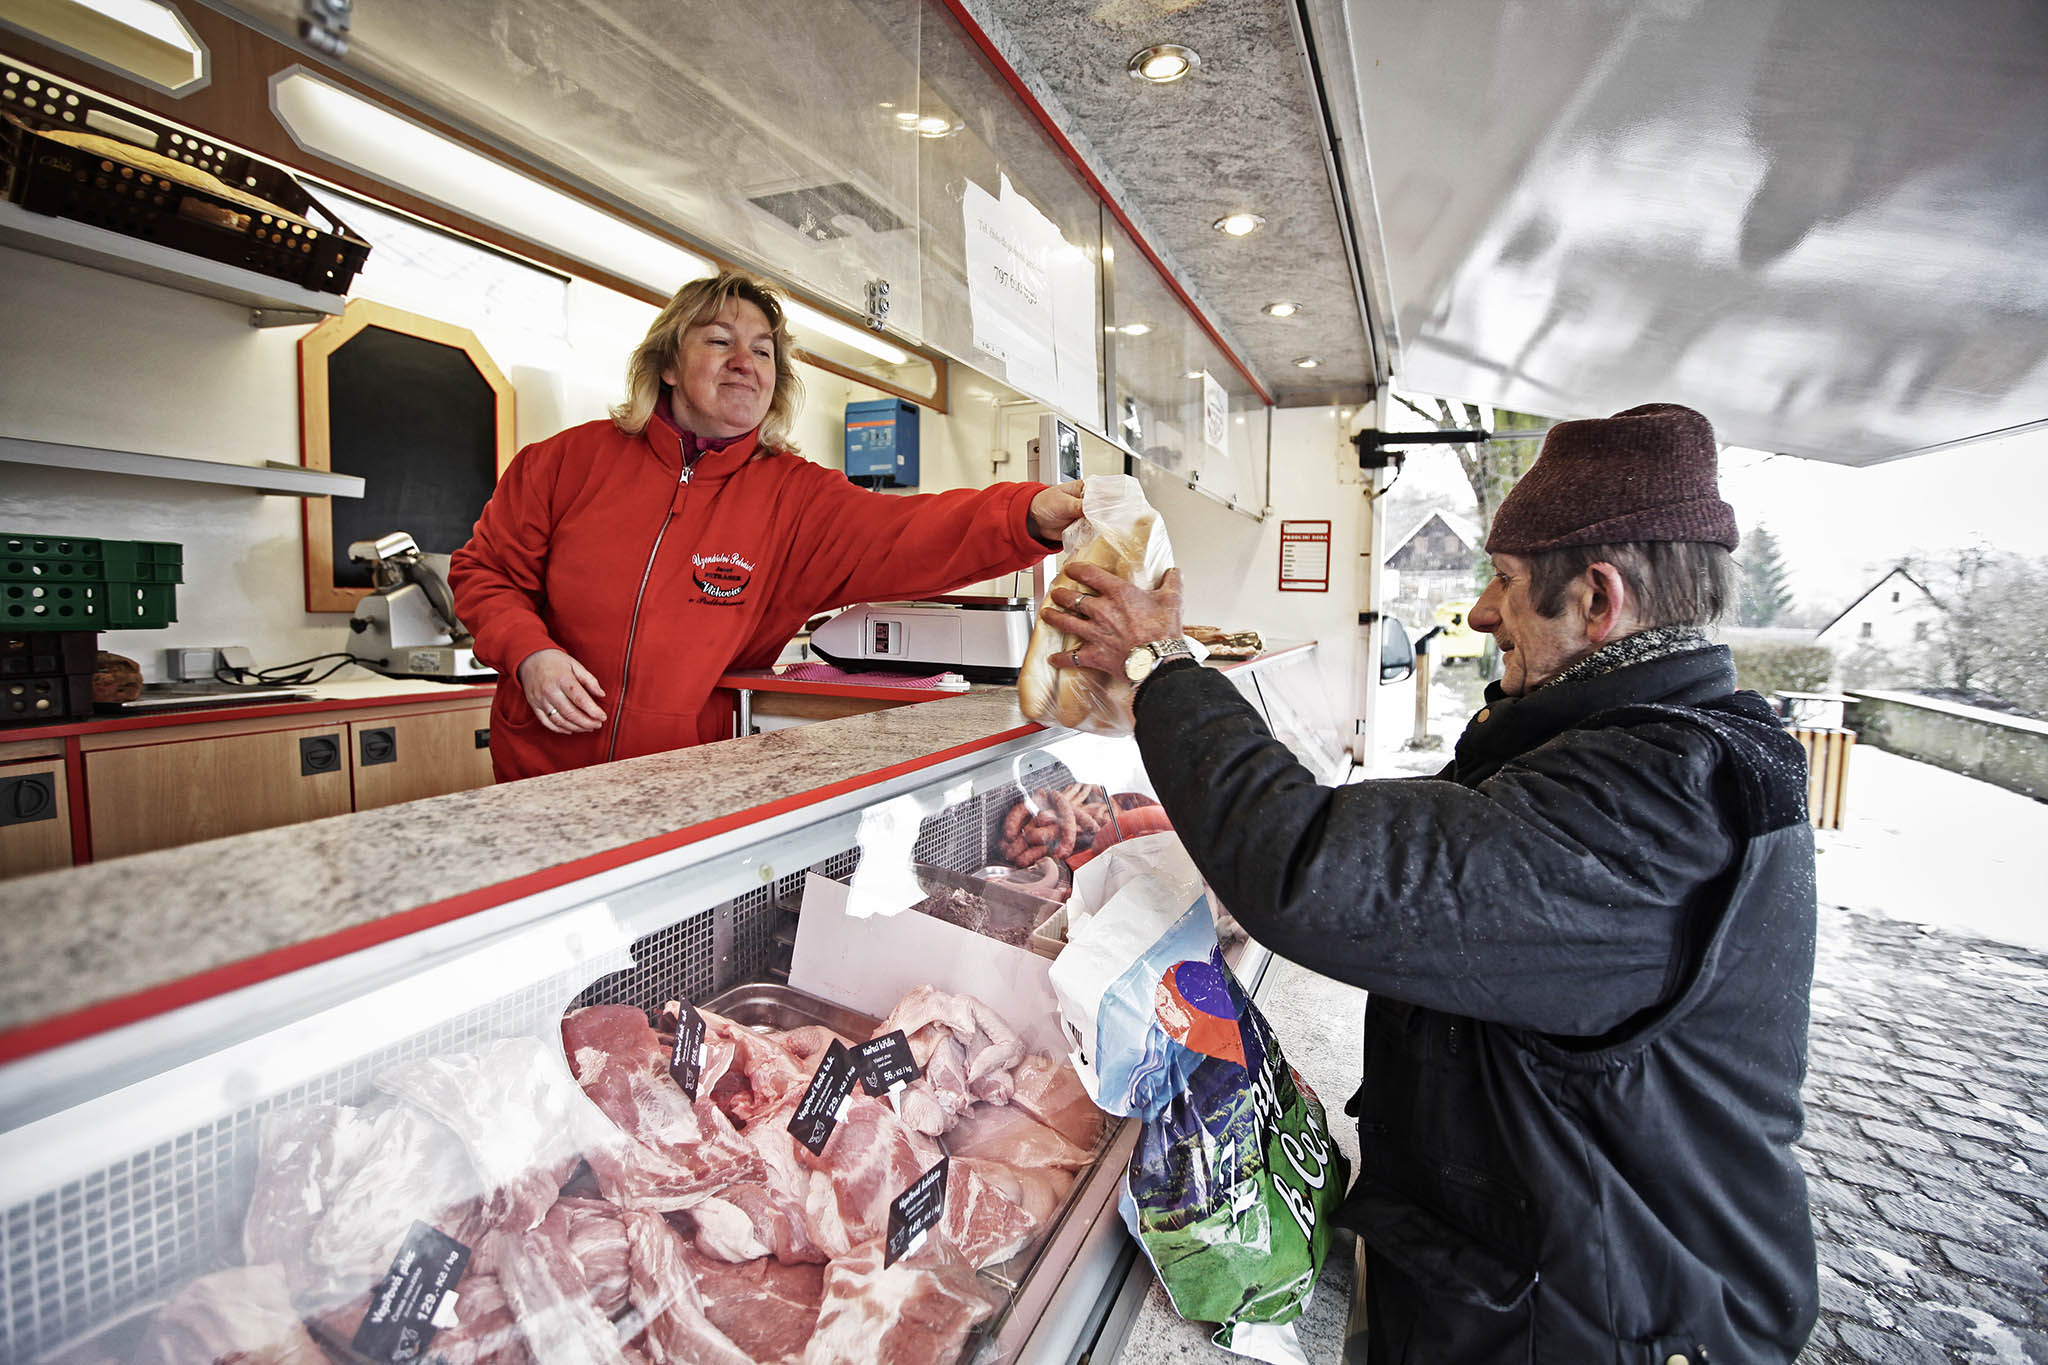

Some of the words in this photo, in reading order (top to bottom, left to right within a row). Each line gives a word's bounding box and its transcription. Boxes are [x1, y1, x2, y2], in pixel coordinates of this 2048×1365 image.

[994, 266, 1008, 287] 797
[814, 1072, 826, 1089] bok
[826, 1094, 841, 1116] 129,-
[417, 1289, 439, 1320] 129,-
[436, 1272, 447, 1287] Kč
[446, 1251, 459, 1265] kg
